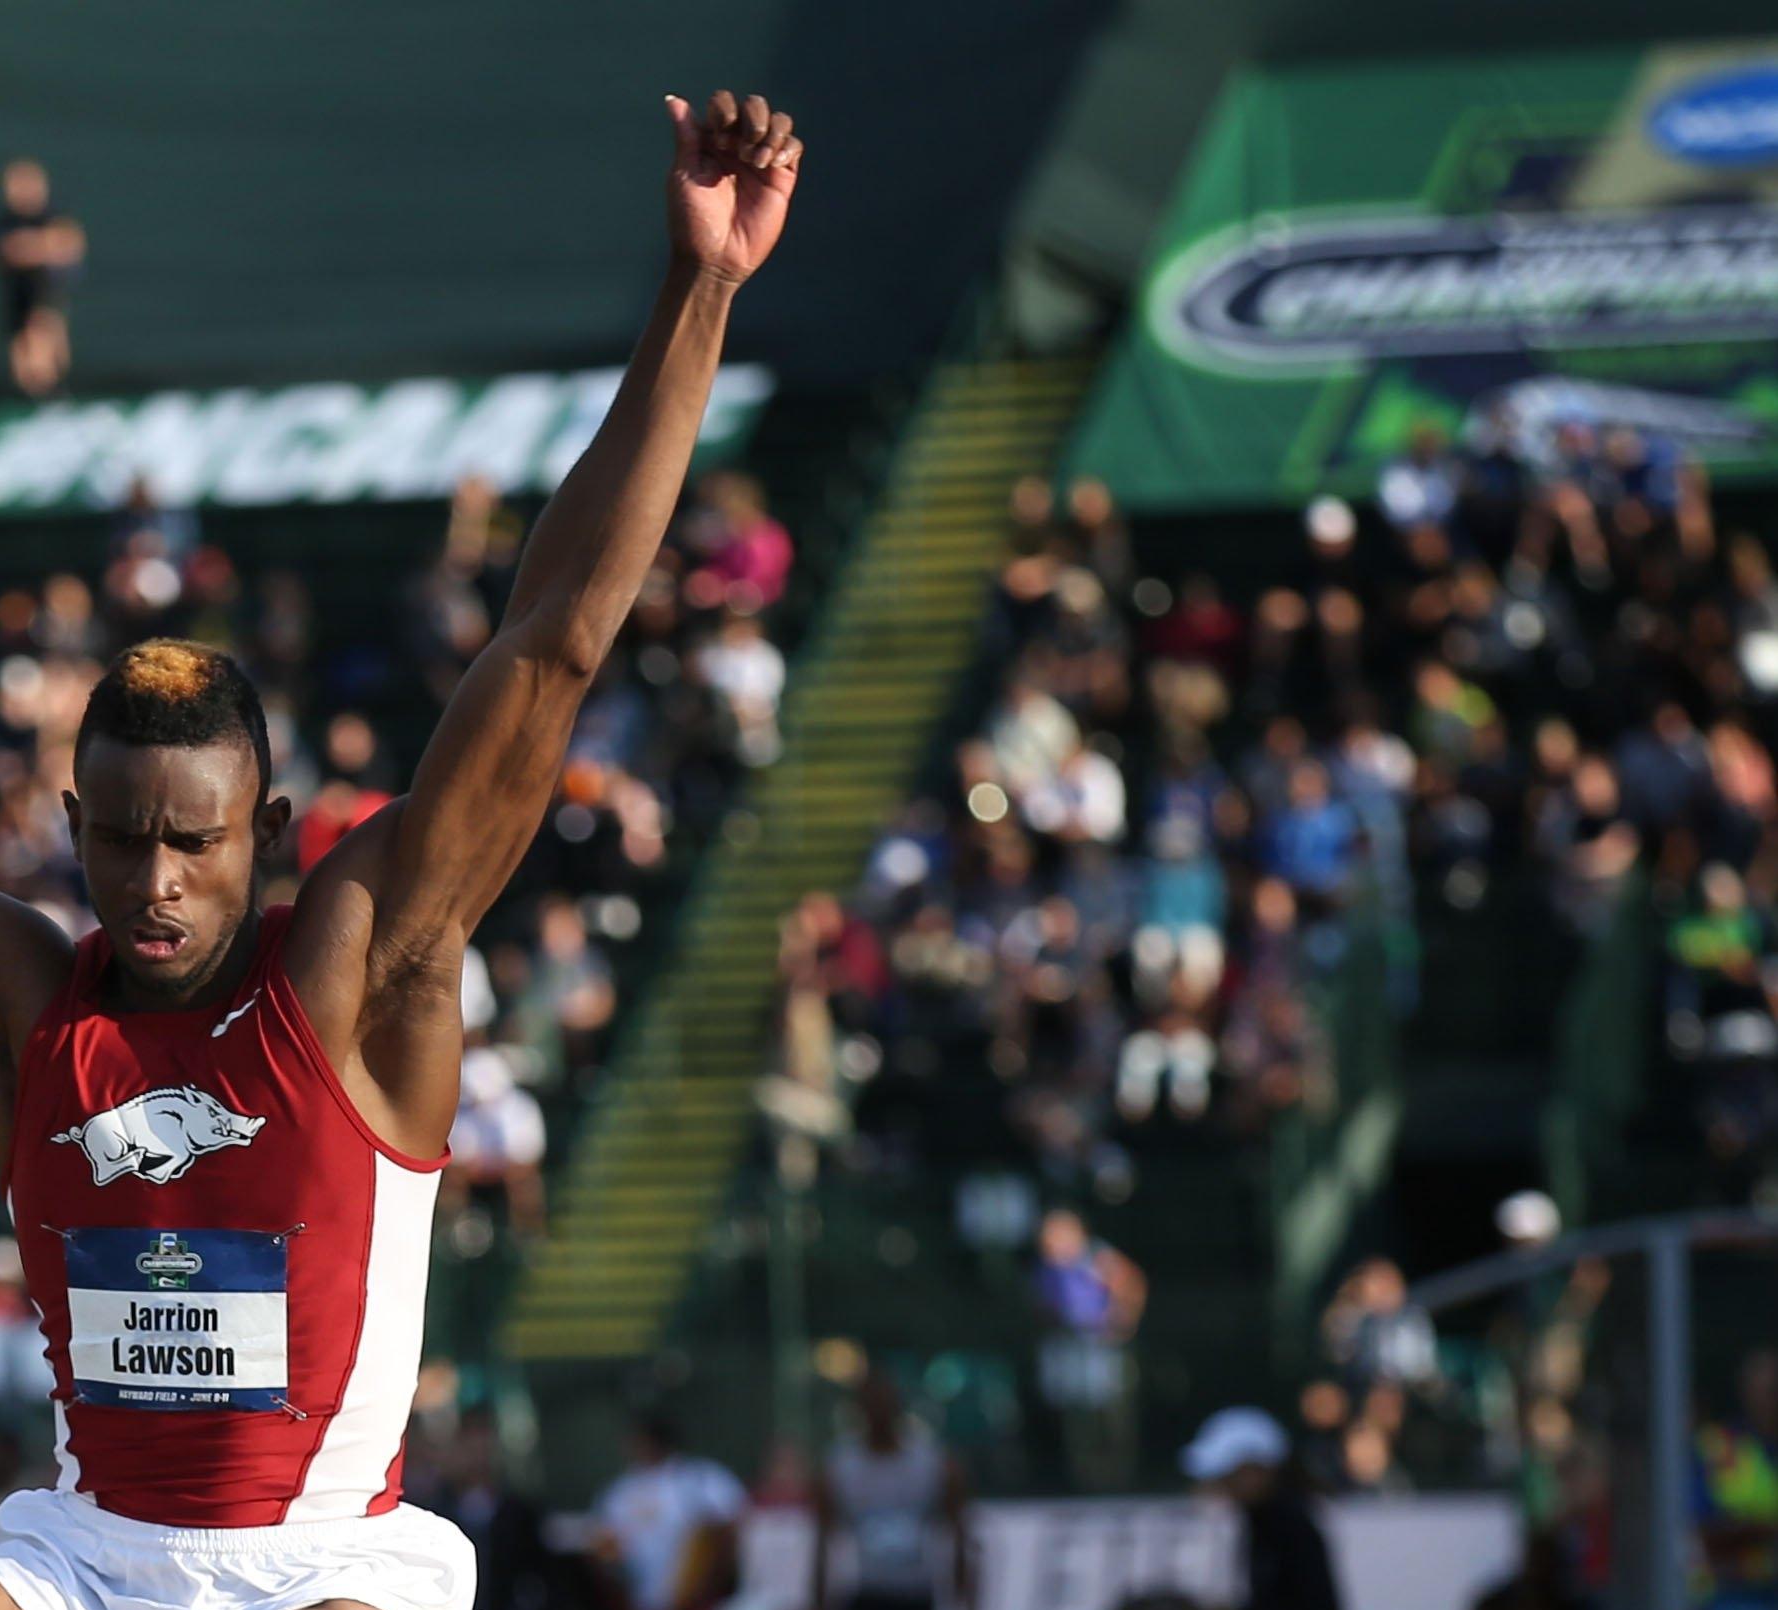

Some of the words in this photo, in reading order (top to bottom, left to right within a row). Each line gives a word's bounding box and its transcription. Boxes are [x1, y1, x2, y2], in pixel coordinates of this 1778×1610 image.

[124, 1301, 218, 1332] Jarrion
[111, 1336, 236, 1377] Lawson
[118, 1389, 154, 1402] HAYWARD
[155, 1391, 177, 1402] FIELD
[189, 1392, 213, 1403] JUNE
